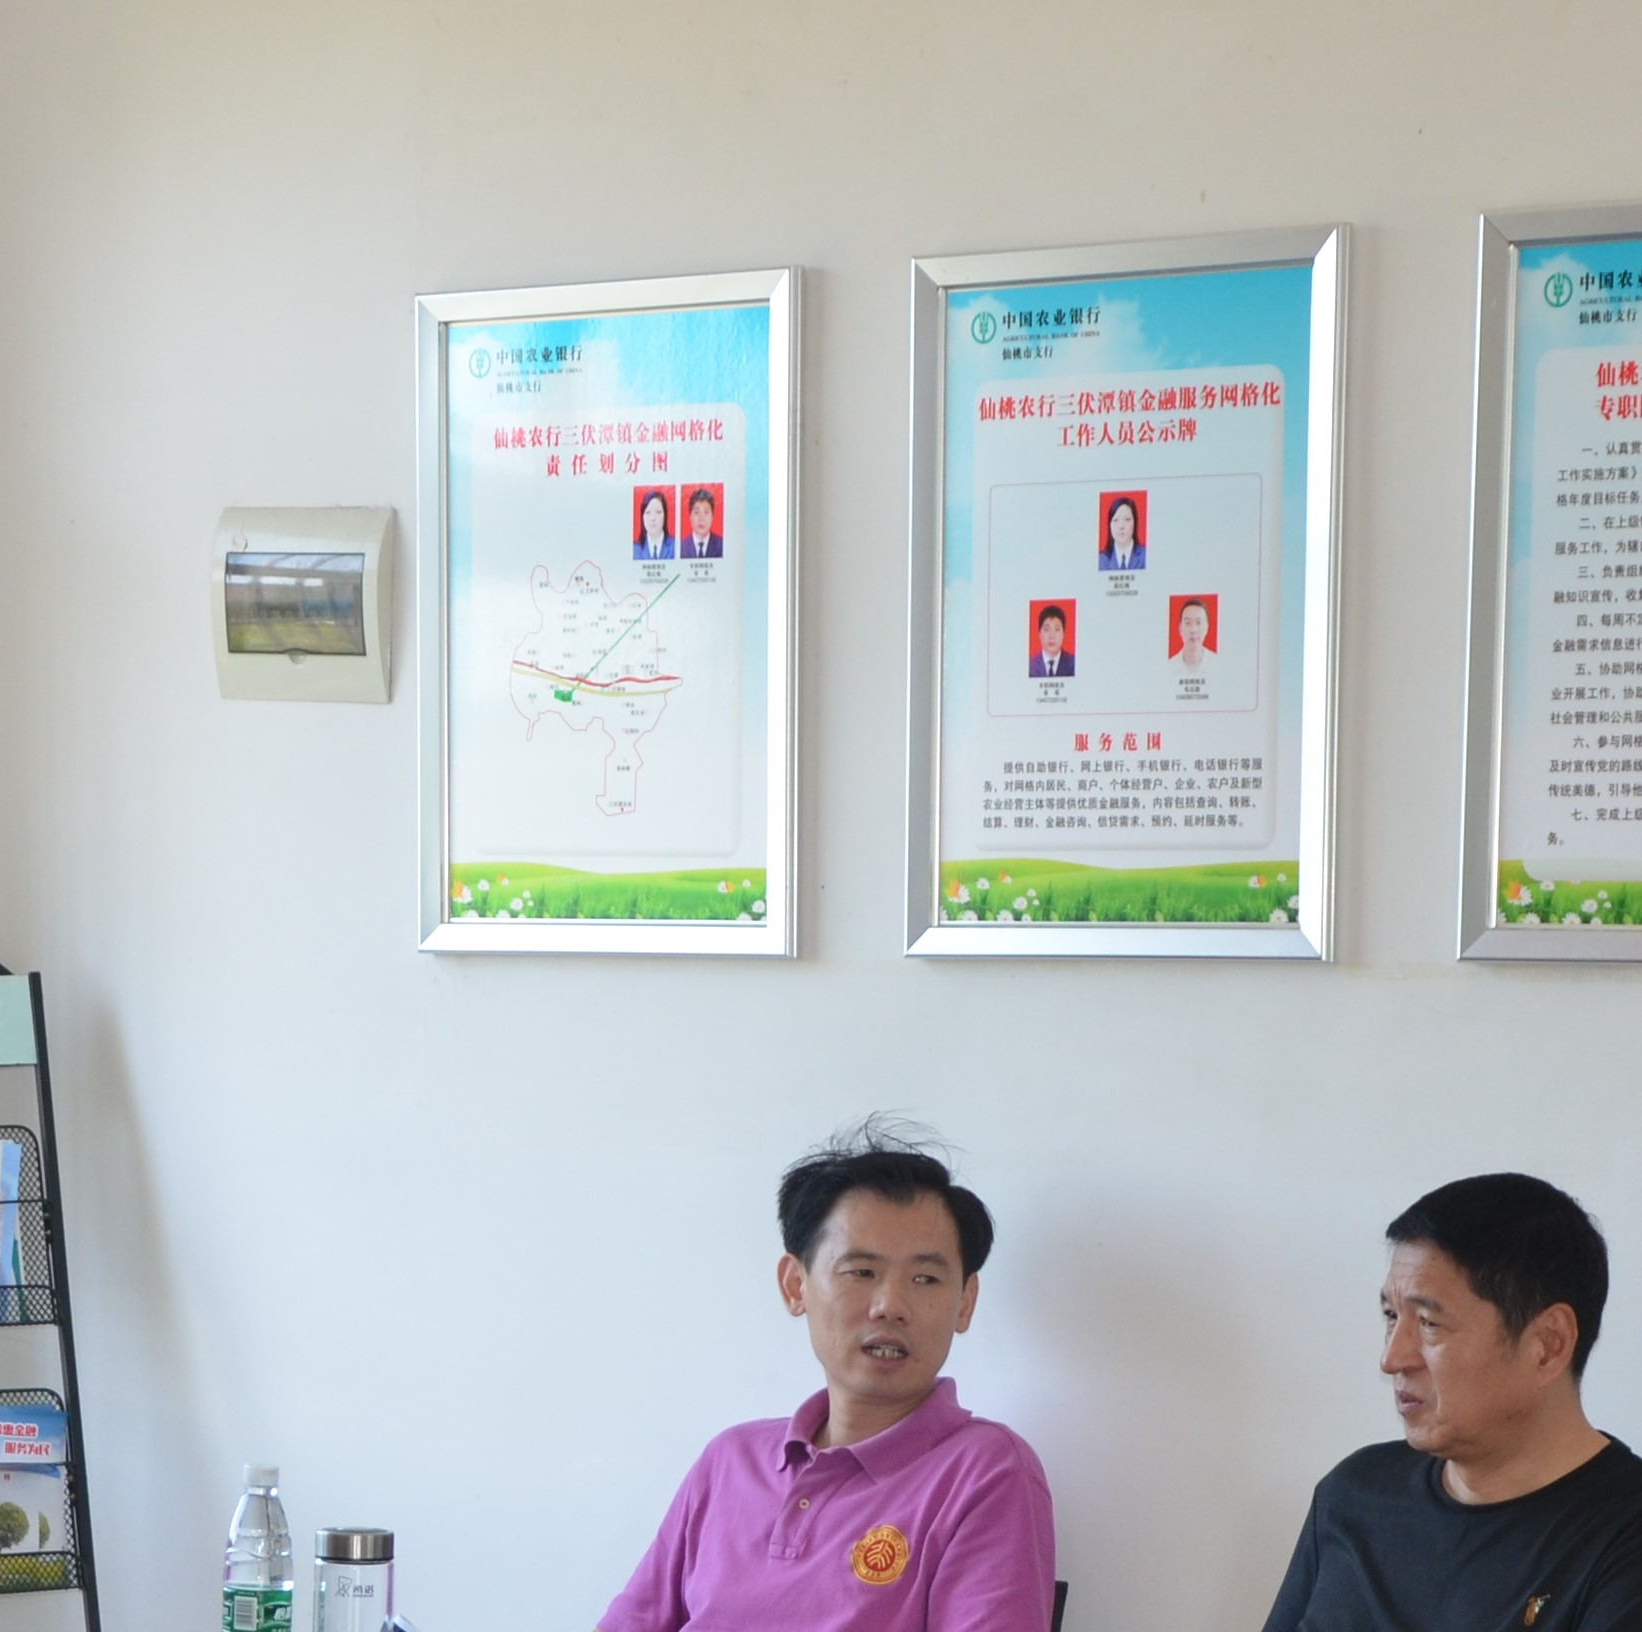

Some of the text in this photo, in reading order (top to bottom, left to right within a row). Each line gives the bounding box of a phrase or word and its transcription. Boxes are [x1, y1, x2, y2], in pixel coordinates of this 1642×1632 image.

[1002, 306, 1101, 329] 中国农业银行
[1579, 308, 1637, 326] 仙桃市支行
[496, 344, 583, 365] 中国农业银行
[1002, 344, 1054, 361] 仙桃市支行
[497, 380, 541, 394] 仙桃市支行
[979, 381, 1281, 421] 仙桃农行三伏潭镇金融服务网格化
[493, 418, 724, 450] 仙桃农行三伏潭镇金融网格化
[1057, 418, 1197, 448] 工作人员公示牌
[546, 451, 669, 477] 责任划分图
[1074, 732, 1163, 752] 服务范围
[5, 1442, 51, 1456] 服务为民
